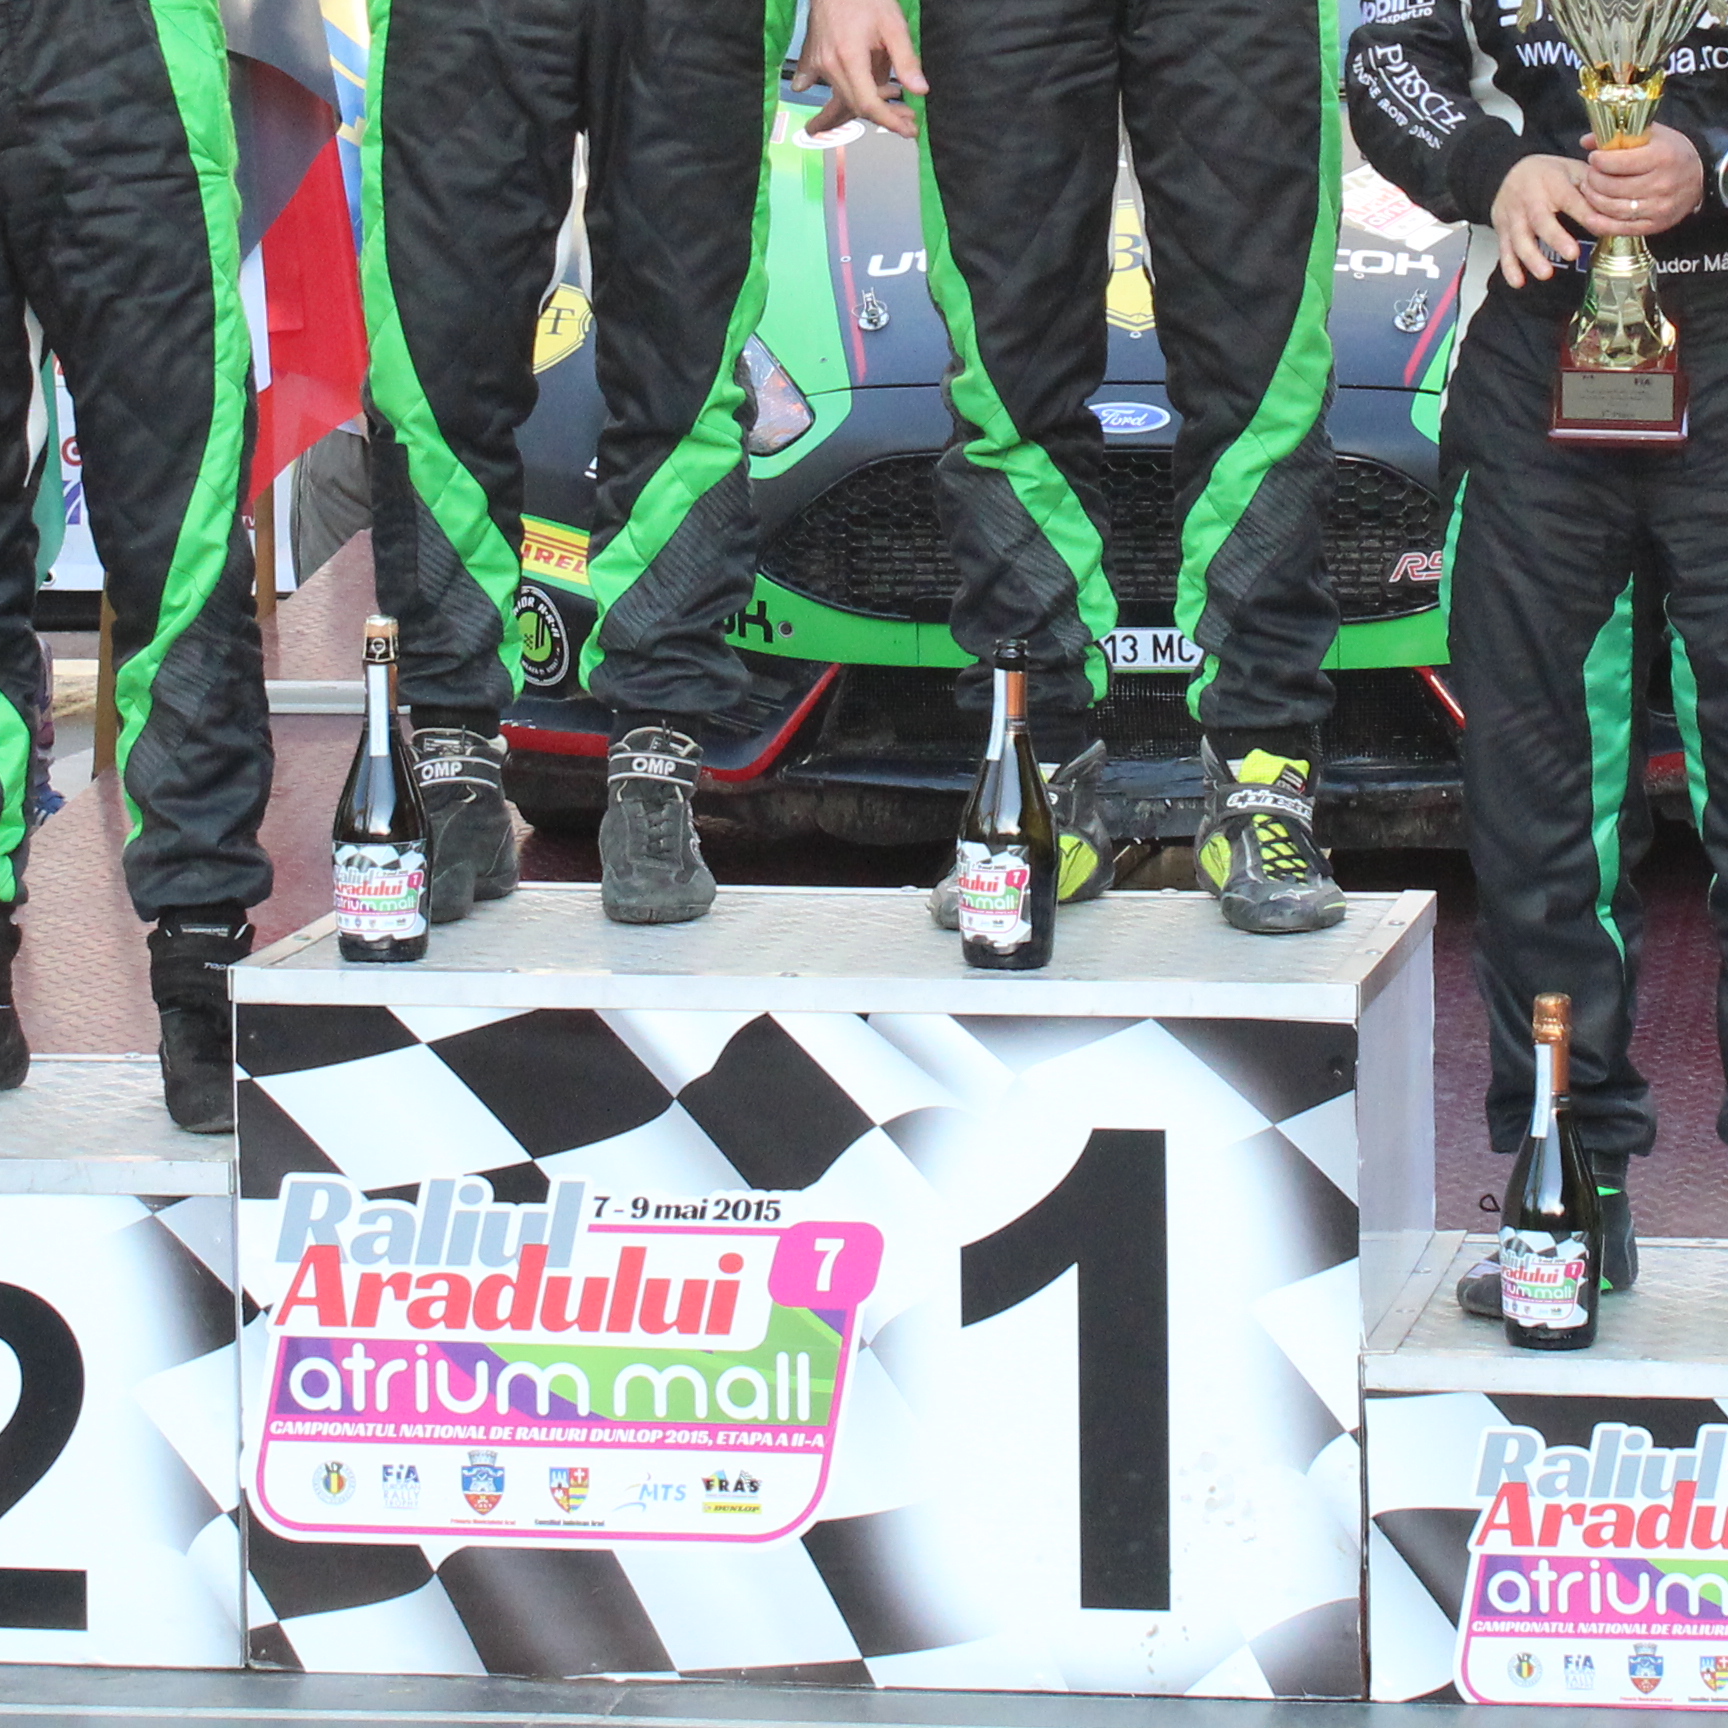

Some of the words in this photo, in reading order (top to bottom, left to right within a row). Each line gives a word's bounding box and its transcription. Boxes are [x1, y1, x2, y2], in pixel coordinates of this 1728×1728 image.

[1656, 255, 1700, 274] udor
[1099, 408, 1148, 428] Ford
[421, 762, 463, 780] OMP
[632, 757, 676, 776] OMP
[593, 1195, 610, 1219] 7
[631, 1197, 650, 1220] 9
[654, 1197, 709, 1221] mai
[713, 1198, 782, 1222] 2015
[276, 1179, 586, 1269] Raliul
[813, 1238, 846, 1292] 7
[274, 1243, 745, 1336] Aradului
[960, 1128, 1172, 1612] 1
[289, 1342, 591, 1417] atrium
[612, 1351, 812, 1422] mall
[269, 1419, 398, 1438] CAMPIONATUL
[399, 1424, 486, 1441] NATIONAL
[488, 1425, 512, 1441] DE
[514, 1426, 588, 1443] RALIURI
[589, 1428, 663, 1444] DUNLOP
[714, 1432, 773, 1447] ETAPA
[774, 1433, 790, 1447] A
[790, 1433, 825, 1448] II-A
[382, 1464, 420, 1483] FiA
[639, 1482, 686, 1503] MTS
[704, 1477, 760, 1494] FRAS
[712, 1503, 761, 1514] DUNLOP
[1471, 1621, 1576, 1634] CAMPIONATUL
[1577, 1623, 1648, 1636] NATIONAL
[1650, 1624, 1671, 1636] DE
